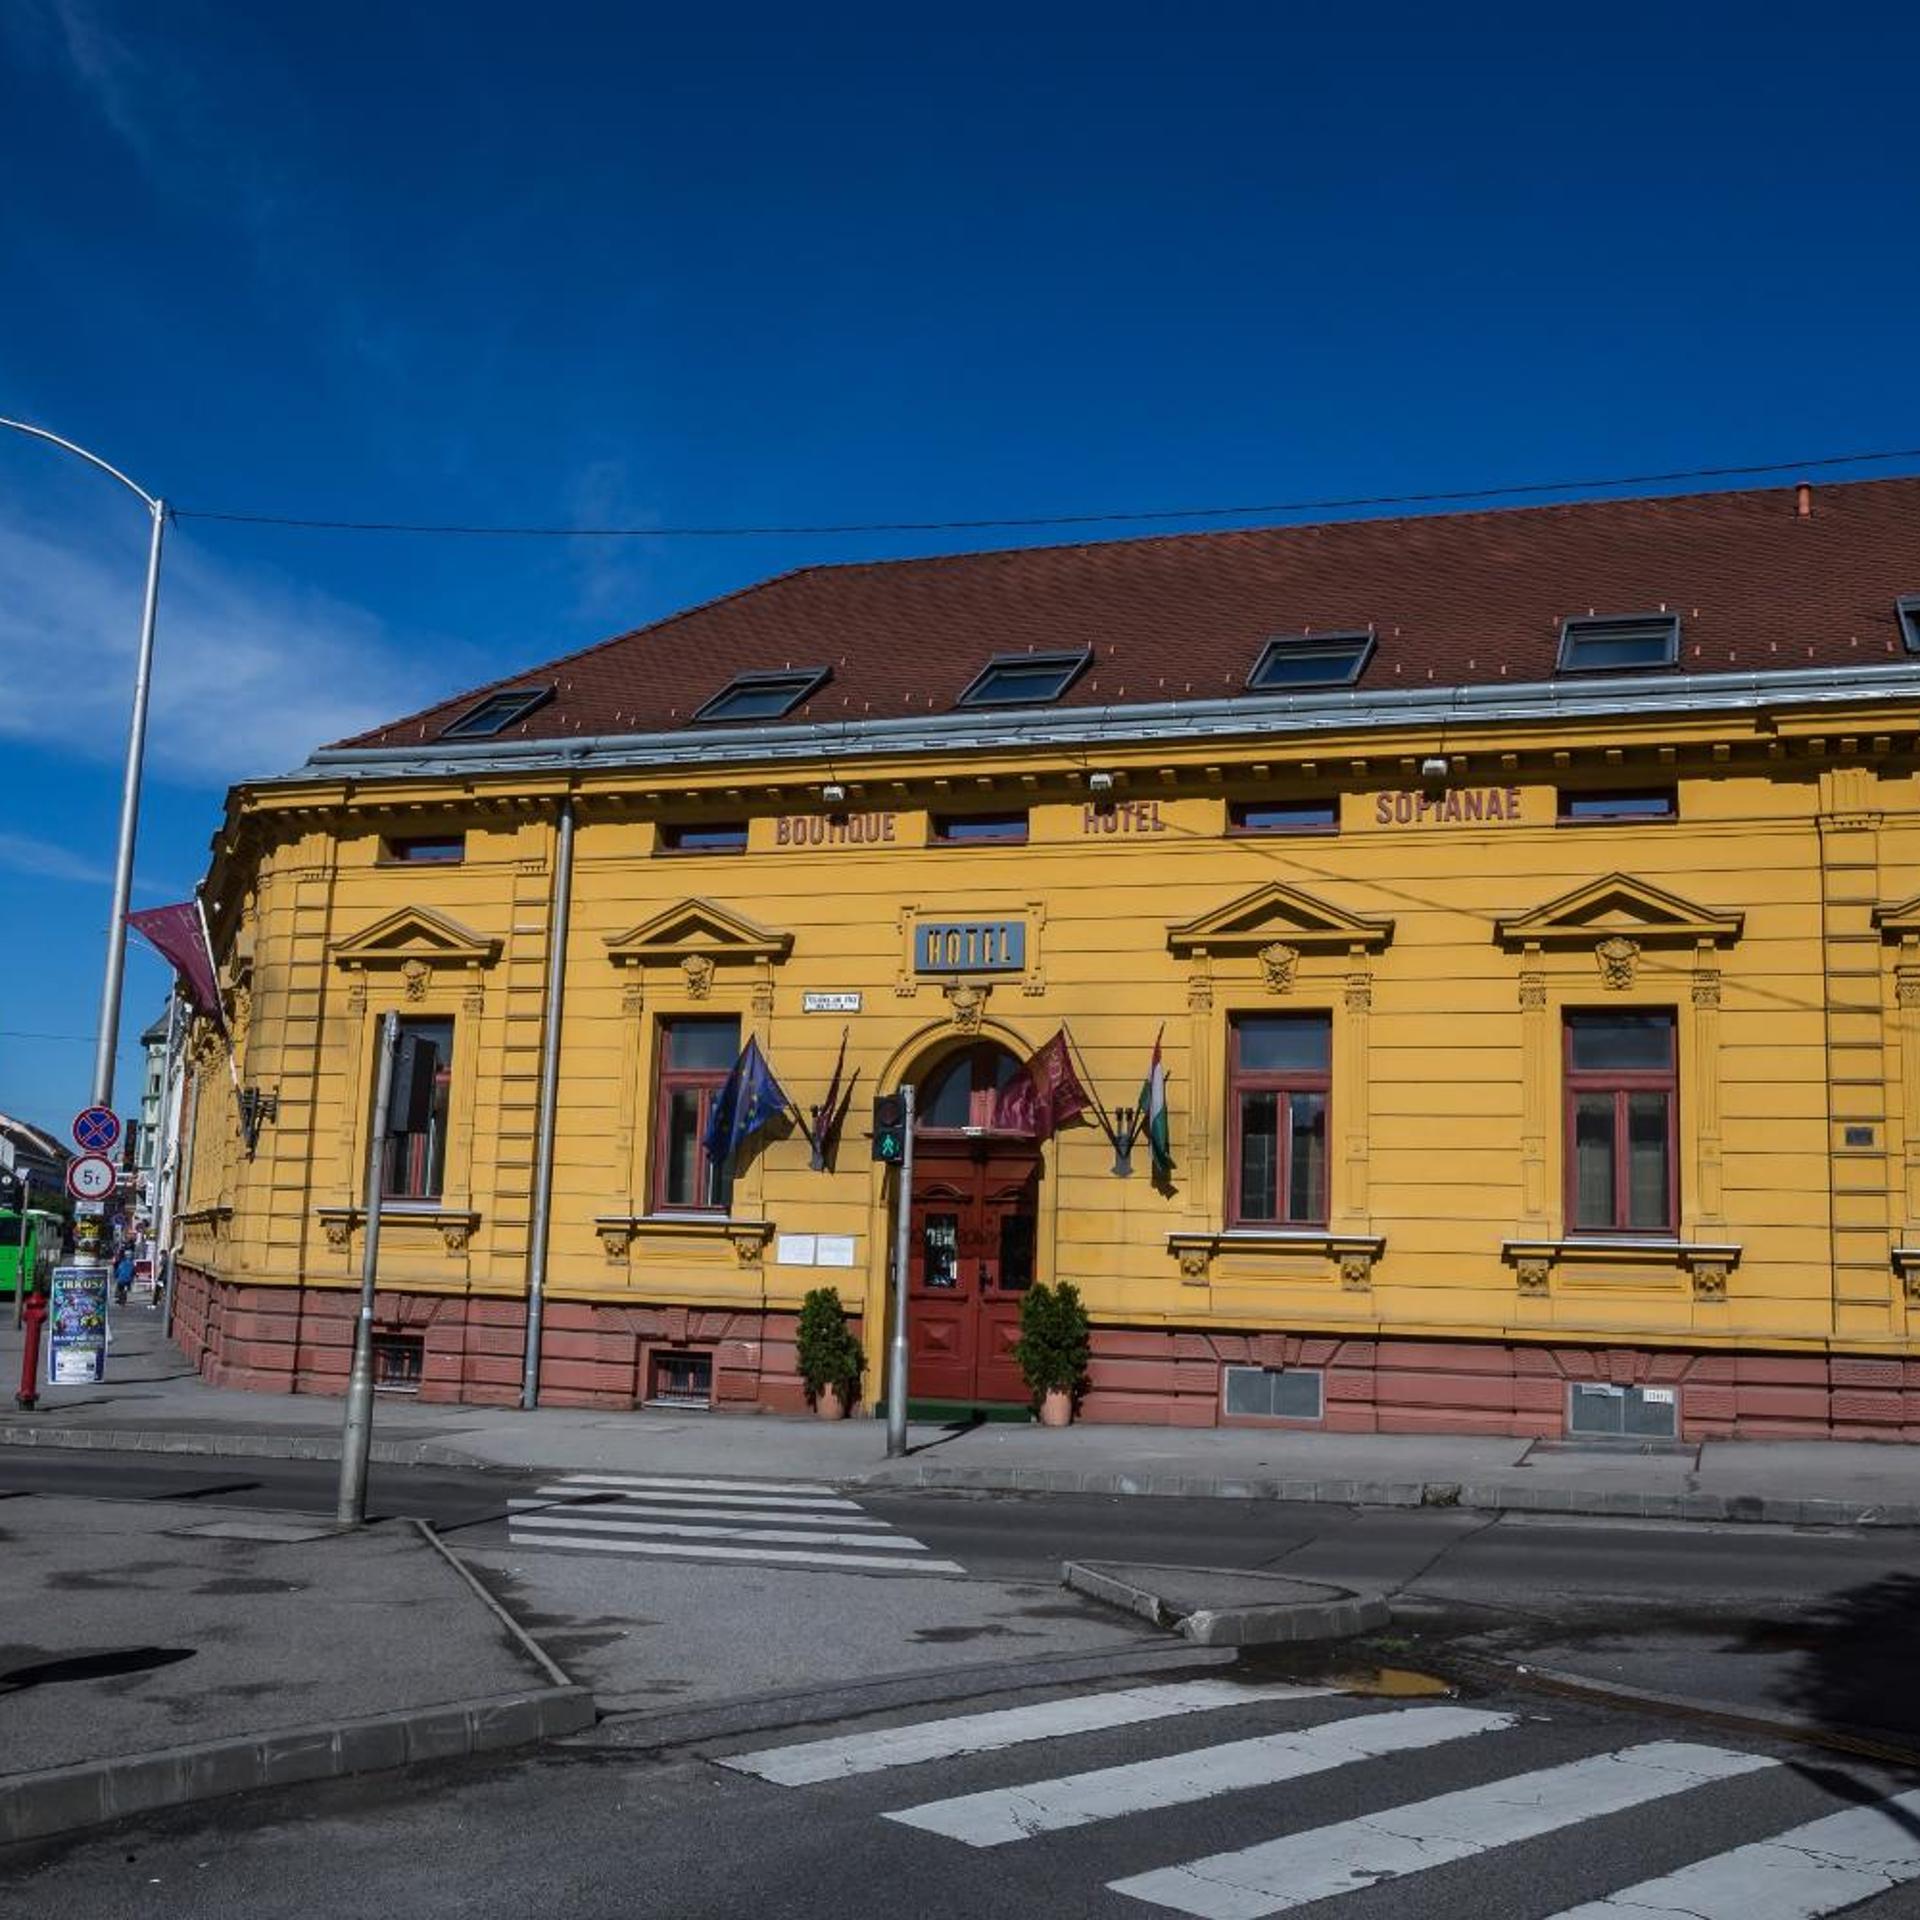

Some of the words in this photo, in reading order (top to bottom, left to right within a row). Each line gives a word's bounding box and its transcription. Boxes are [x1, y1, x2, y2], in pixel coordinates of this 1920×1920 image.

[776, 813, 895, 845] BOUTIQUE
[1084, 801, 1165, 833] HOTEL
[1376, 788, 1521, 824] SOPIANAE
[927, 927, 1011, 966] HOTEL
[55, 1279, 105, 1290] CIRKUSZ
